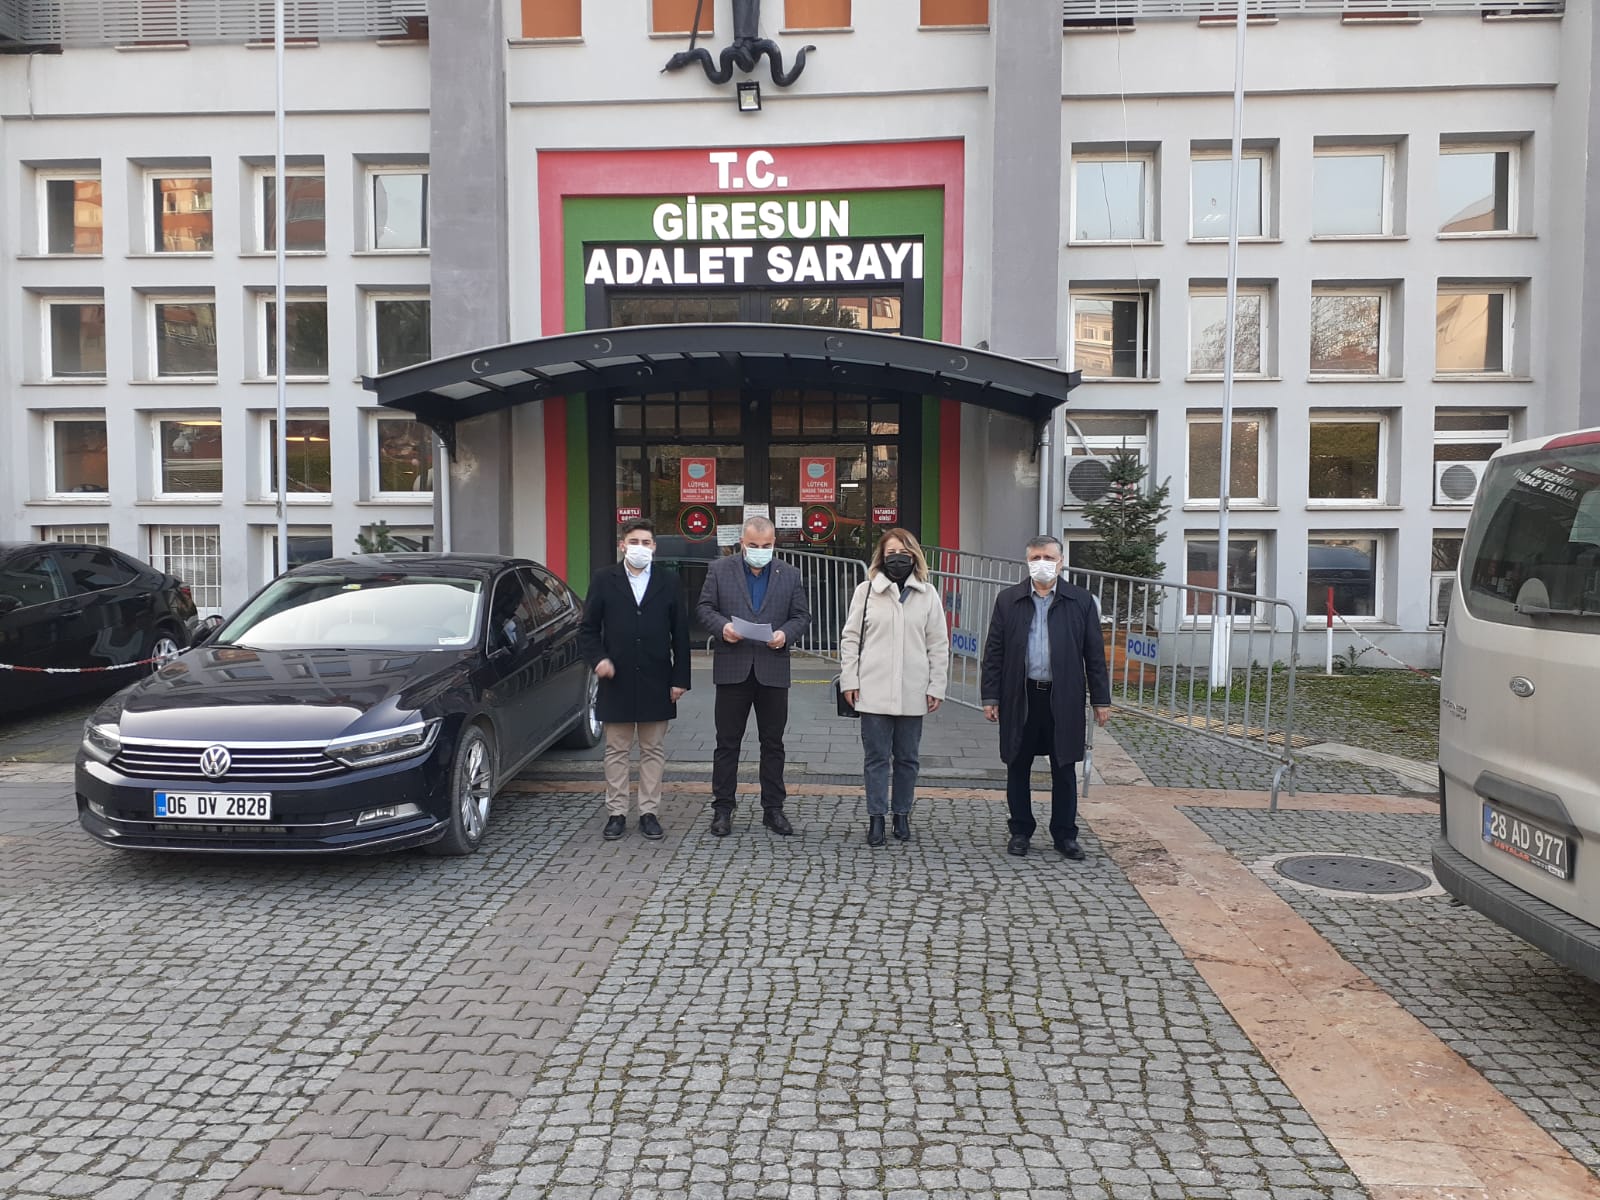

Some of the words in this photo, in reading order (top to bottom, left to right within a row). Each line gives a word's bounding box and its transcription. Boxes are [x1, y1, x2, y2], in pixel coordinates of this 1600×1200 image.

[709, 150, 788, 190] T.C.
[652, 195, 849, 240] GİRESUN
[584, 246, 752, 285] ADALET
[766, 242, 923, 283] SARAYI
[952, 632, 977, 653] POLİS
[1127, 638, 1156, 659] POLİS
[167, 796, 187, 815] 06
[197, 796, 217, 816] DV
[226, 797, 267, 816] 2828
[1490, 811, 1507, 840] 28
[1511, 820, 1530, 850] AD
[1534, 830, 1563, 865] 977
